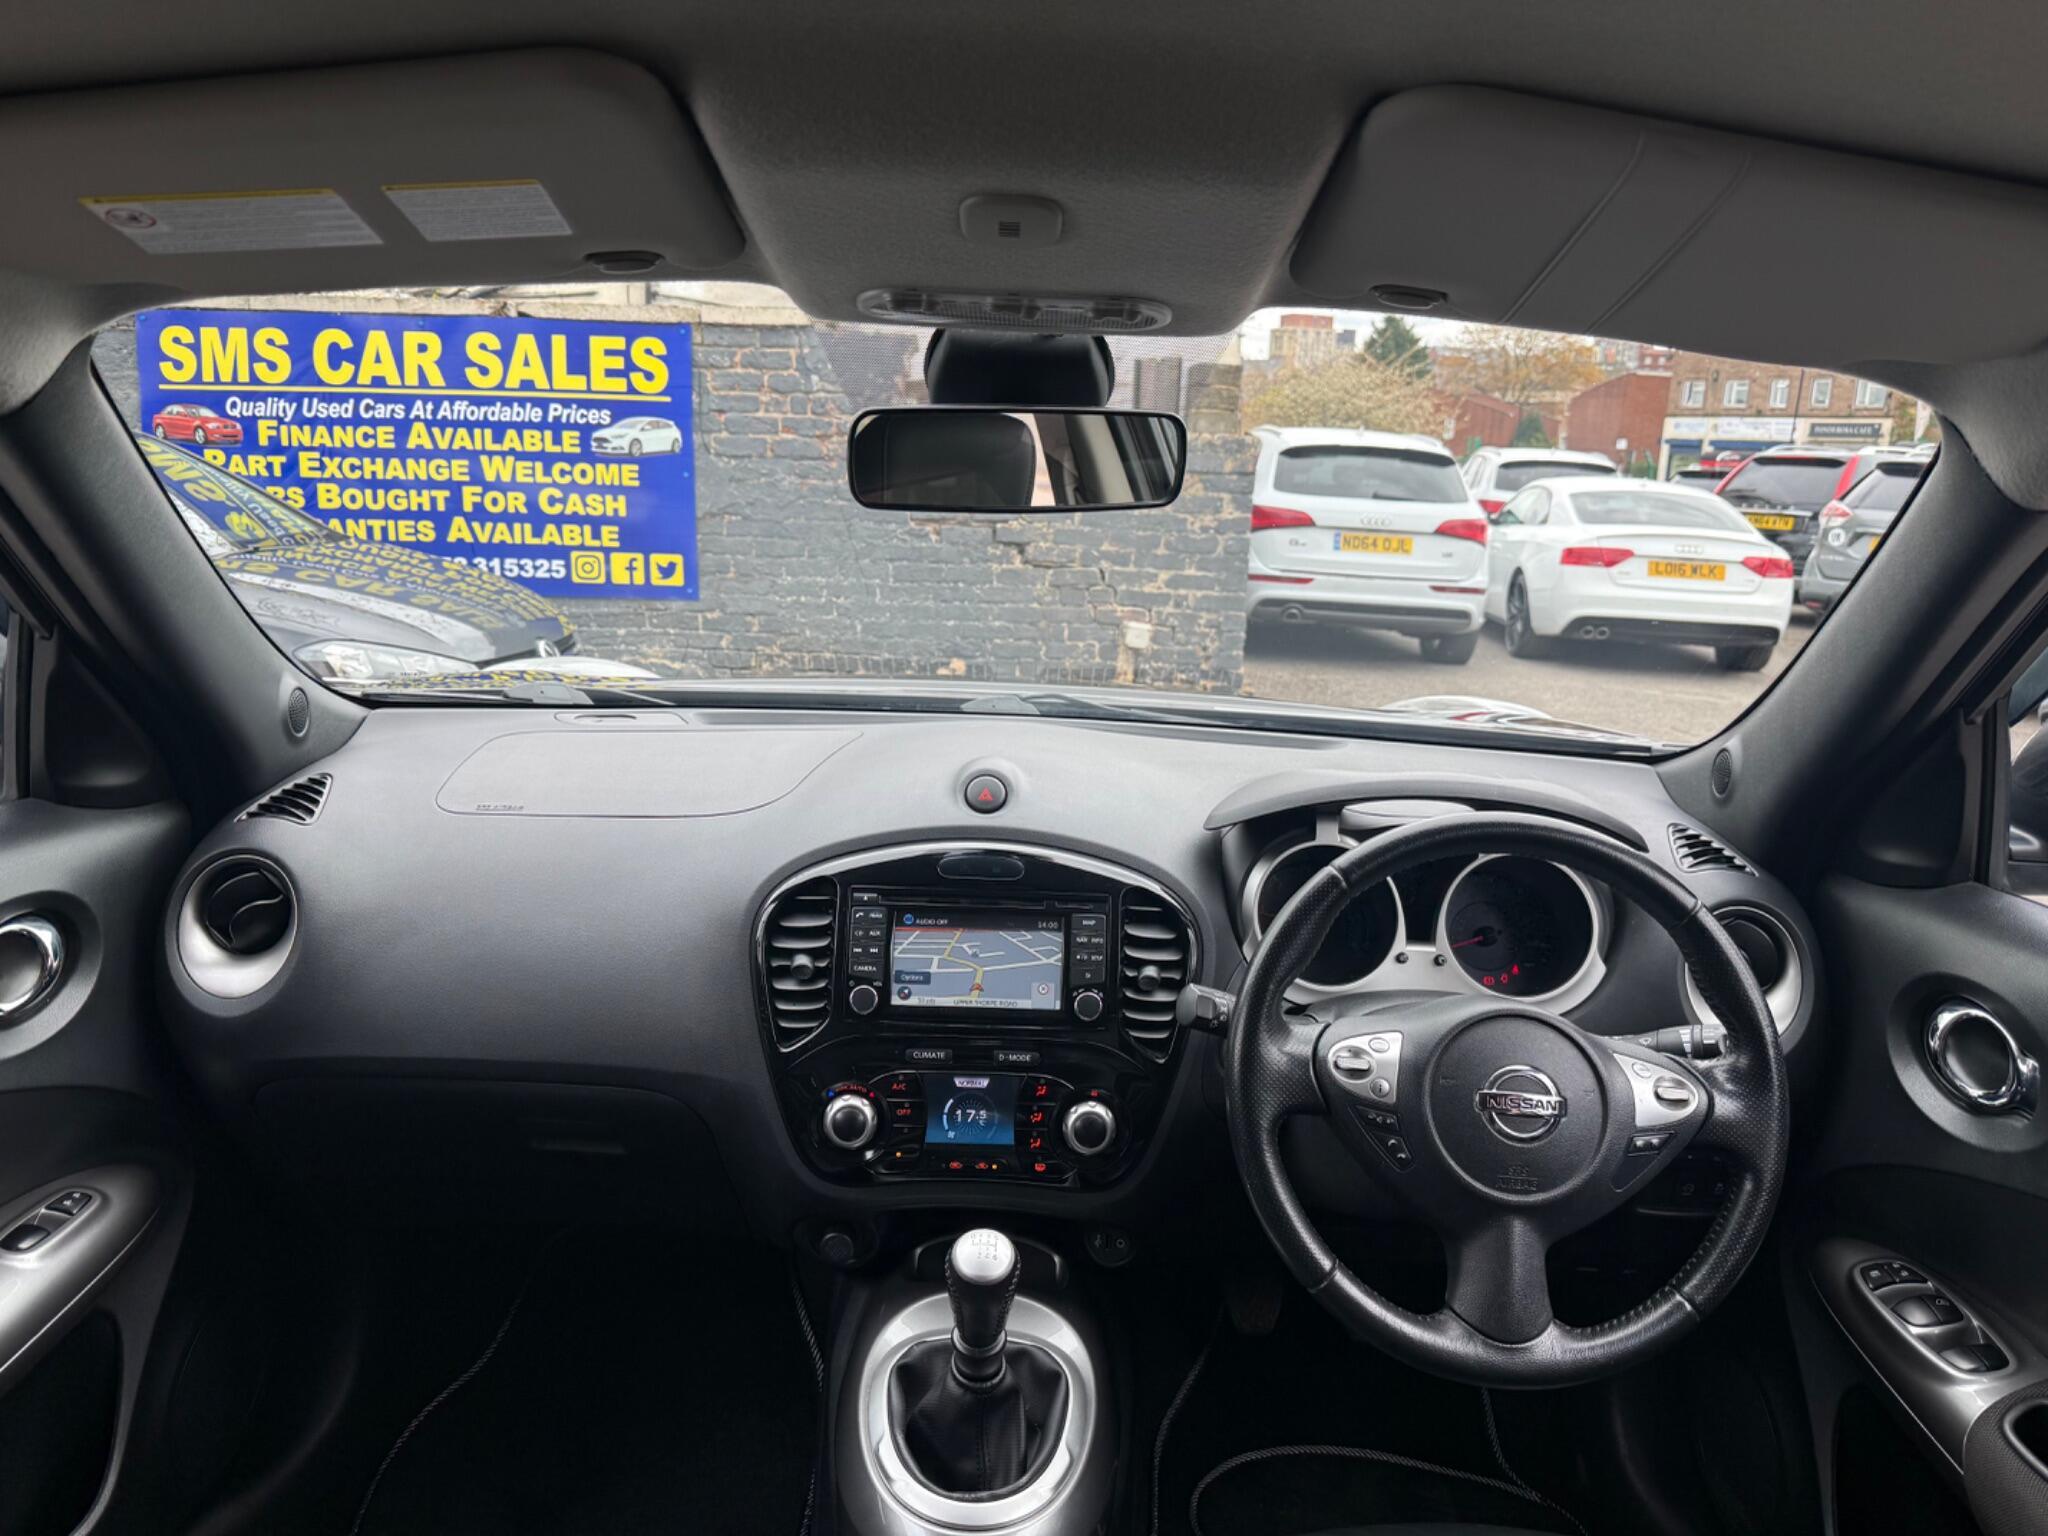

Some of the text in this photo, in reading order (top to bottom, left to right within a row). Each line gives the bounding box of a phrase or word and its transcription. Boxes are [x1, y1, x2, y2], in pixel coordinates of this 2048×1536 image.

[158, 325, 670, 395] SMS CAR SALES
[225, 396, 612, 425] Quality Used Cars At Affordable Prices
[257, 419, 581, 454] FINANCE AVAILABLE
[202, 448, 641, 487] PART EXCHANGE WELCOME
[316, 482, 450, 512] BOUGHT
[461, 485, 528, 514] FOR
[537, 486, 627, 518] CASH
[446, 516, 621, 548] AVAILABLE
[473, 556, 566, 580] 315325
[912, 1051, 945, 1060] CLIMATE
[1486, 1095, 1560, 1114] NISSAN
